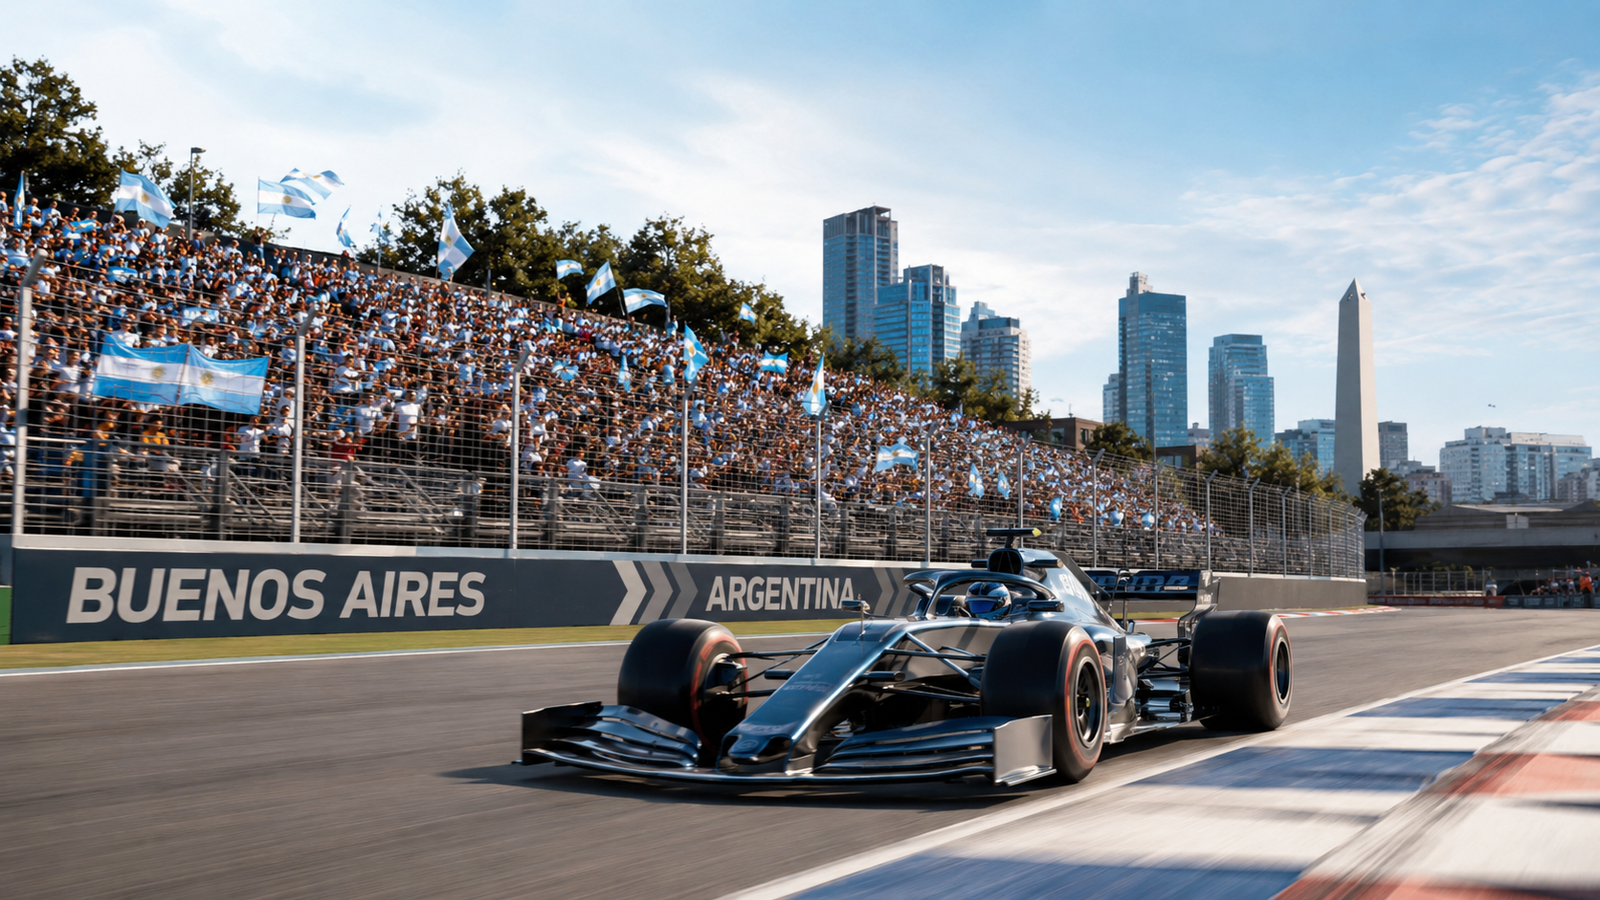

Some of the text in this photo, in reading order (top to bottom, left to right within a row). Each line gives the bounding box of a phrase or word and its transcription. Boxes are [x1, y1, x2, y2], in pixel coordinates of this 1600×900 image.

[66, 567, 486, 624] BUENOS AIRES
[705, 576, 855, 611] ARGENTINA
